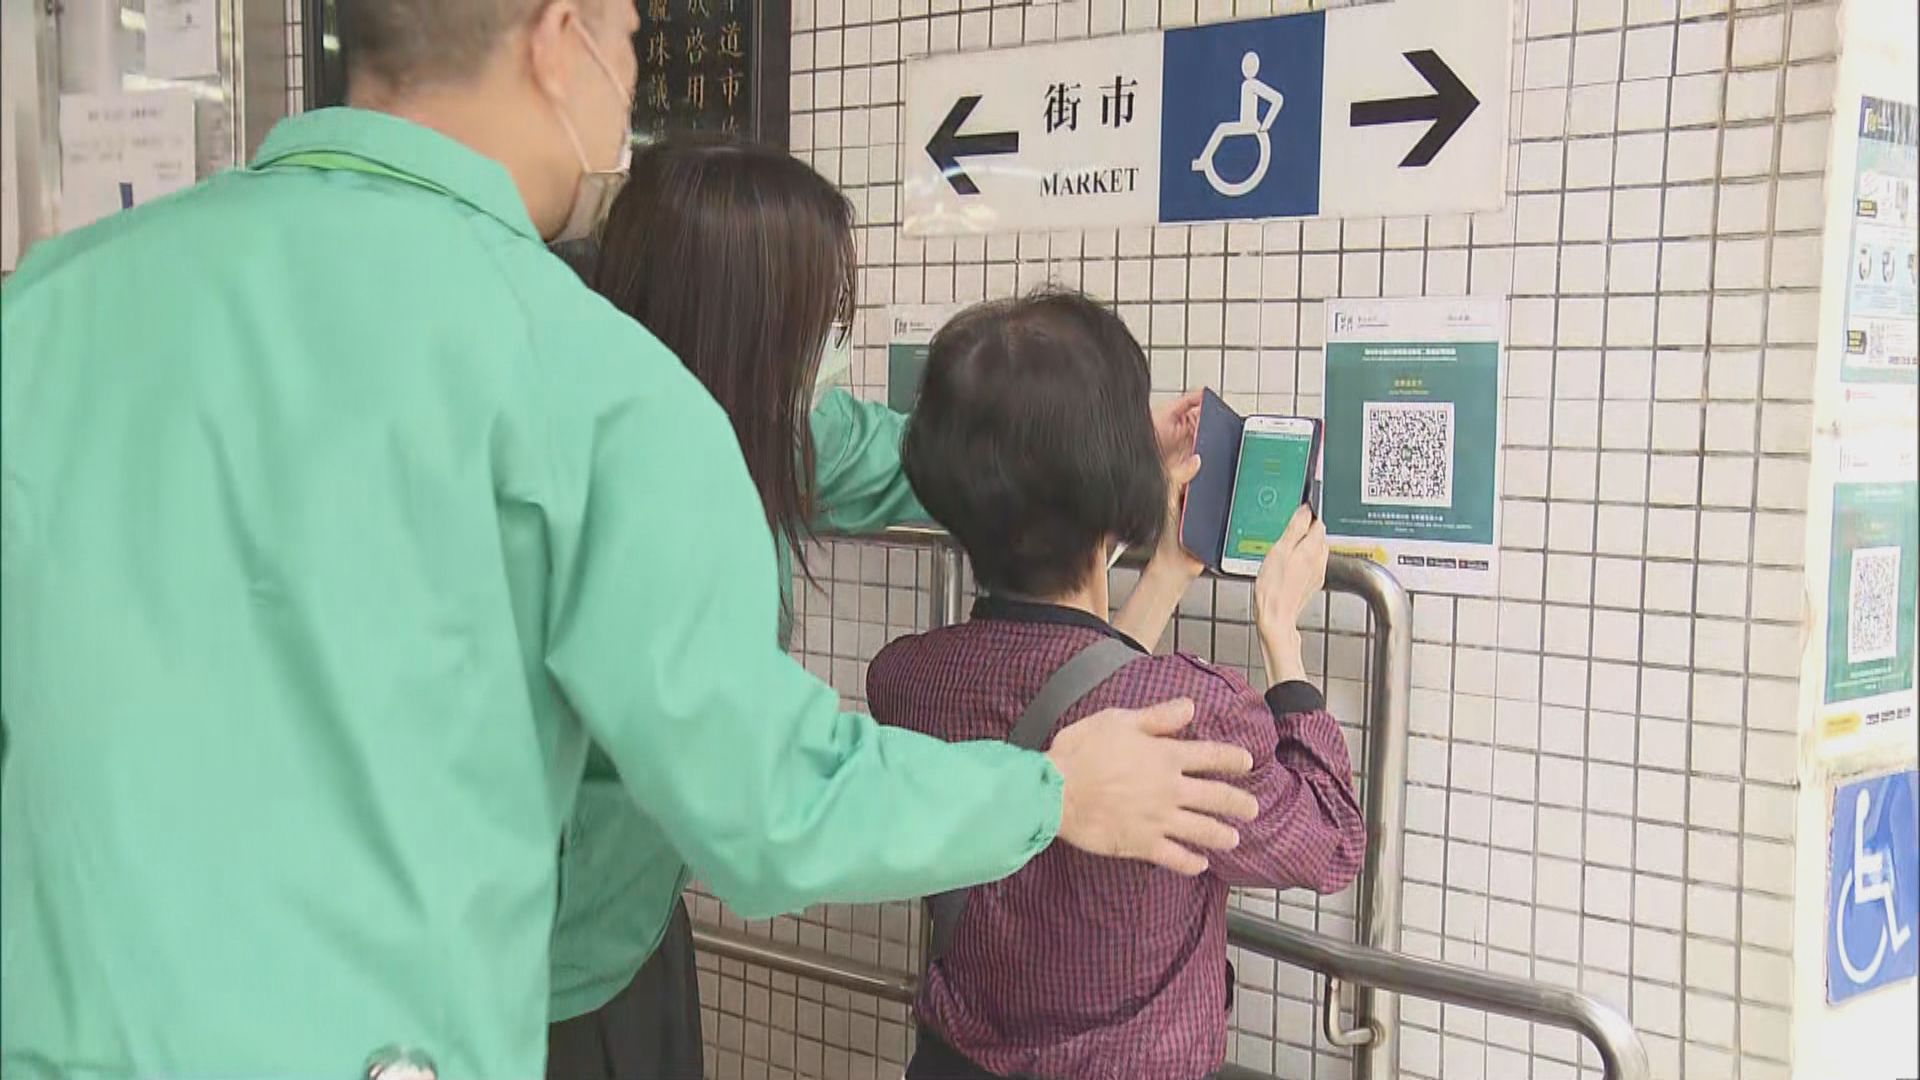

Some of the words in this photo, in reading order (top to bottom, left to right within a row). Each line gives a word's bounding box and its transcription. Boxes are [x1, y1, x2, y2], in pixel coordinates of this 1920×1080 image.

[718, 0, 745, 136] 道市
[1044, 75, 1138, 134] 街市
[1040, 168, 1139, 197] MARKET
